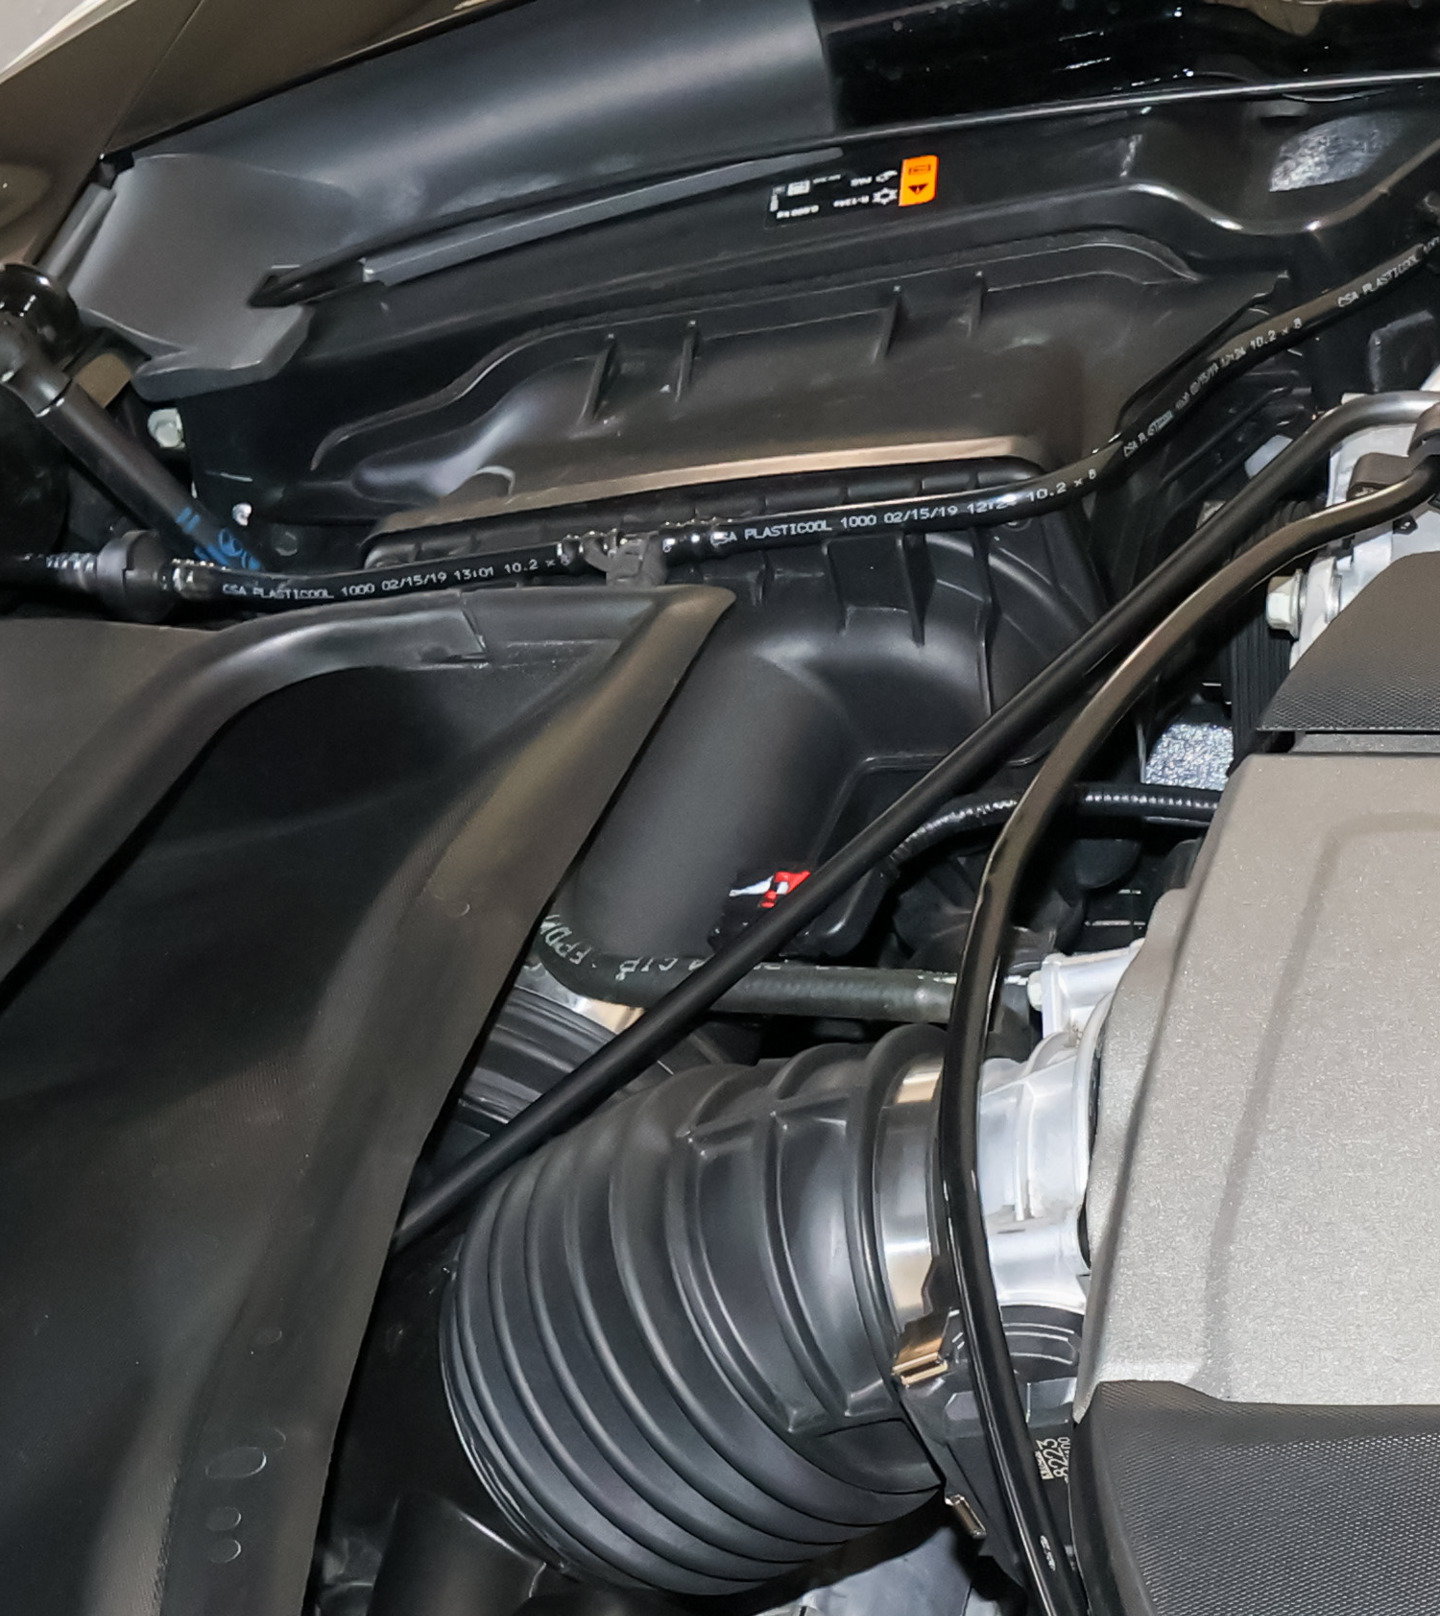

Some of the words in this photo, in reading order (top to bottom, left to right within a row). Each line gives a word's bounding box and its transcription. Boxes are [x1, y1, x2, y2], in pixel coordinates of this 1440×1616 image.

[744, 519, 833, 540] PLASTICOOL
[839, 514, 878, 530] 1000
[883, 504, 959, 525] 02/15/19
[1026, 481, 1068, 503] 10.2
[252, 586, 335, 600] PLASTICOOL
[341, 582, 375, 597] 1000
[381, 570, 449, 592] 02/15/19
[503, 559, 539, 577] 10.2
